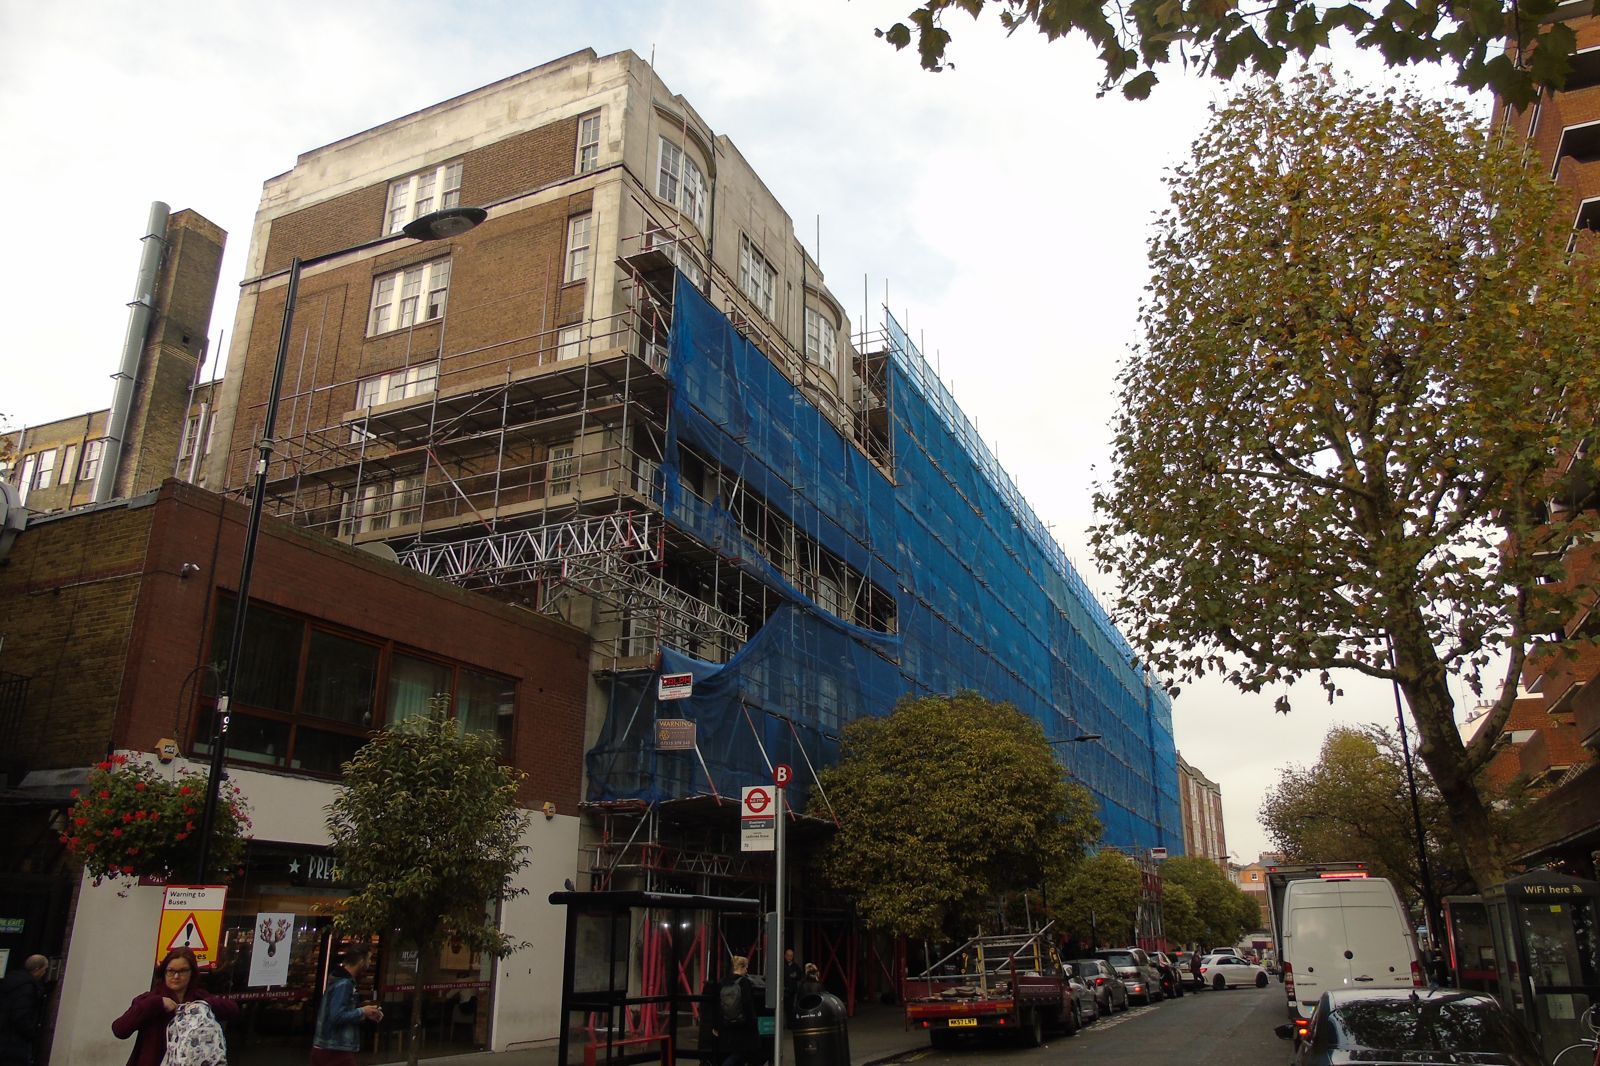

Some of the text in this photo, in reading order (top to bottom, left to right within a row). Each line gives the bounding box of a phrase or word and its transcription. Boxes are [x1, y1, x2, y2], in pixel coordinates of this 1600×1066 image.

[777, 766, 787, 782] B
[308, 855, 339, 881] PRET
[1524, 885, 1570, 894] WiFi here
